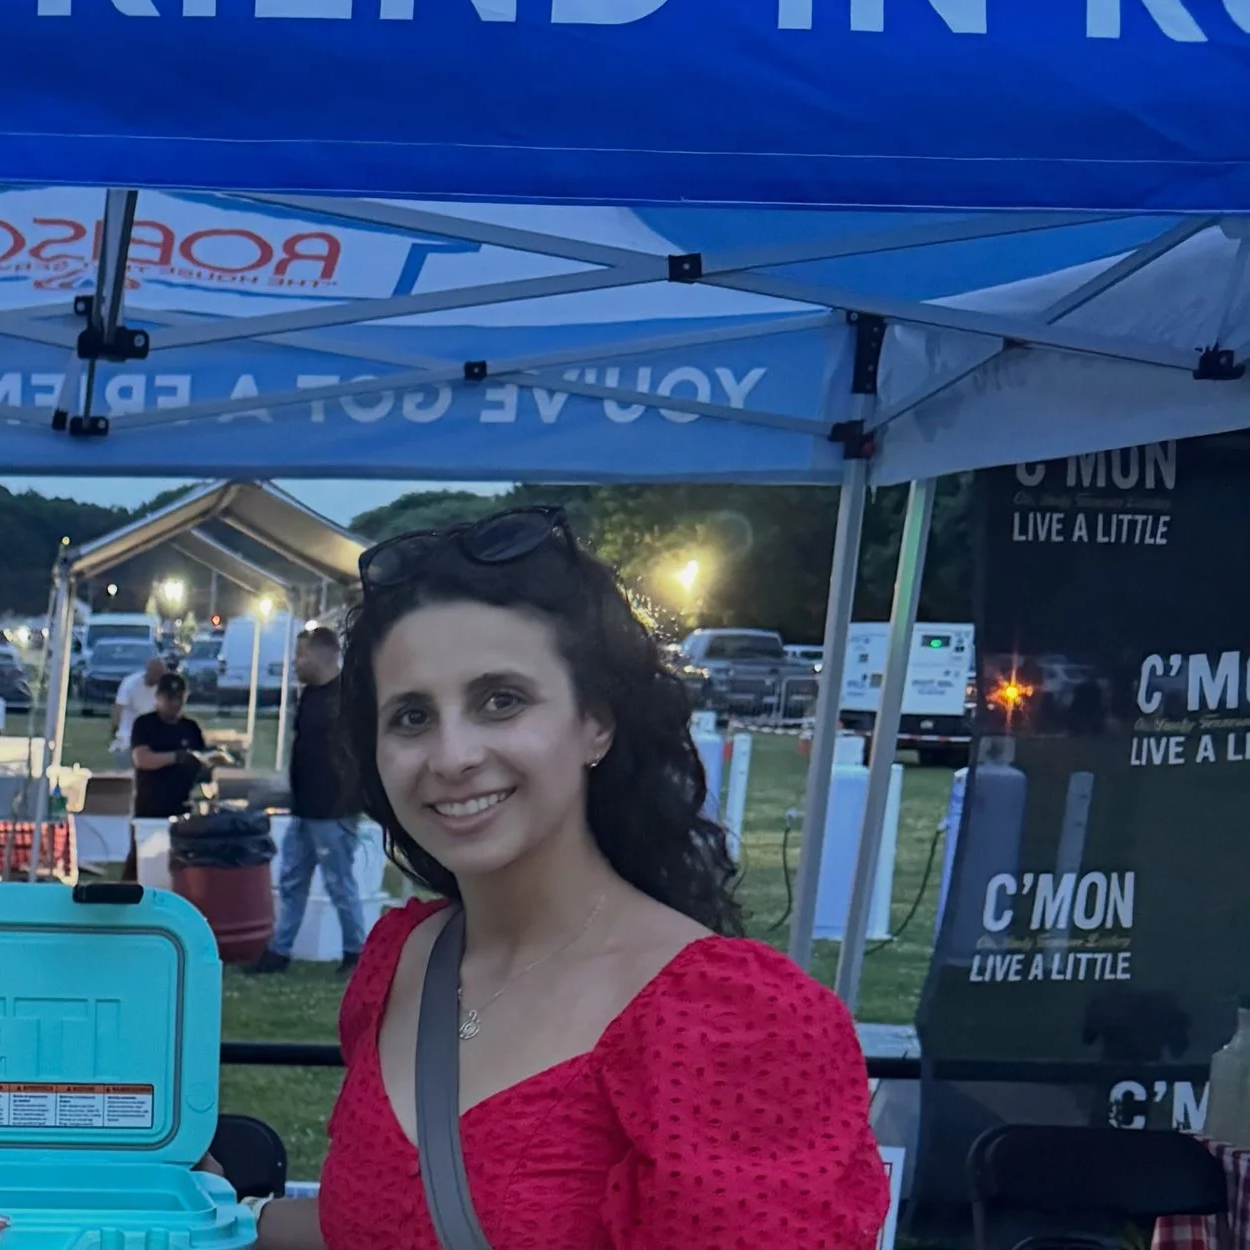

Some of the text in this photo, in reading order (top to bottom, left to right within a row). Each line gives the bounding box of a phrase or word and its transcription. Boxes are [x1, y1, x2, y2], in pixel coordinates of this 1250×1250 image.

[1015, 439, 1177, 490] MON
[1012, 511, 1171, 545] LIVE A LITTLE
[1136, 650, 1250, 714] C'M
[1130, 736, 1186, 766] LIVE
[1195, 733, 1217, 764] A
[982, 871, 1135, 932] C'MON
[969, 951, 1132, 983] LIVE A LITTLE
